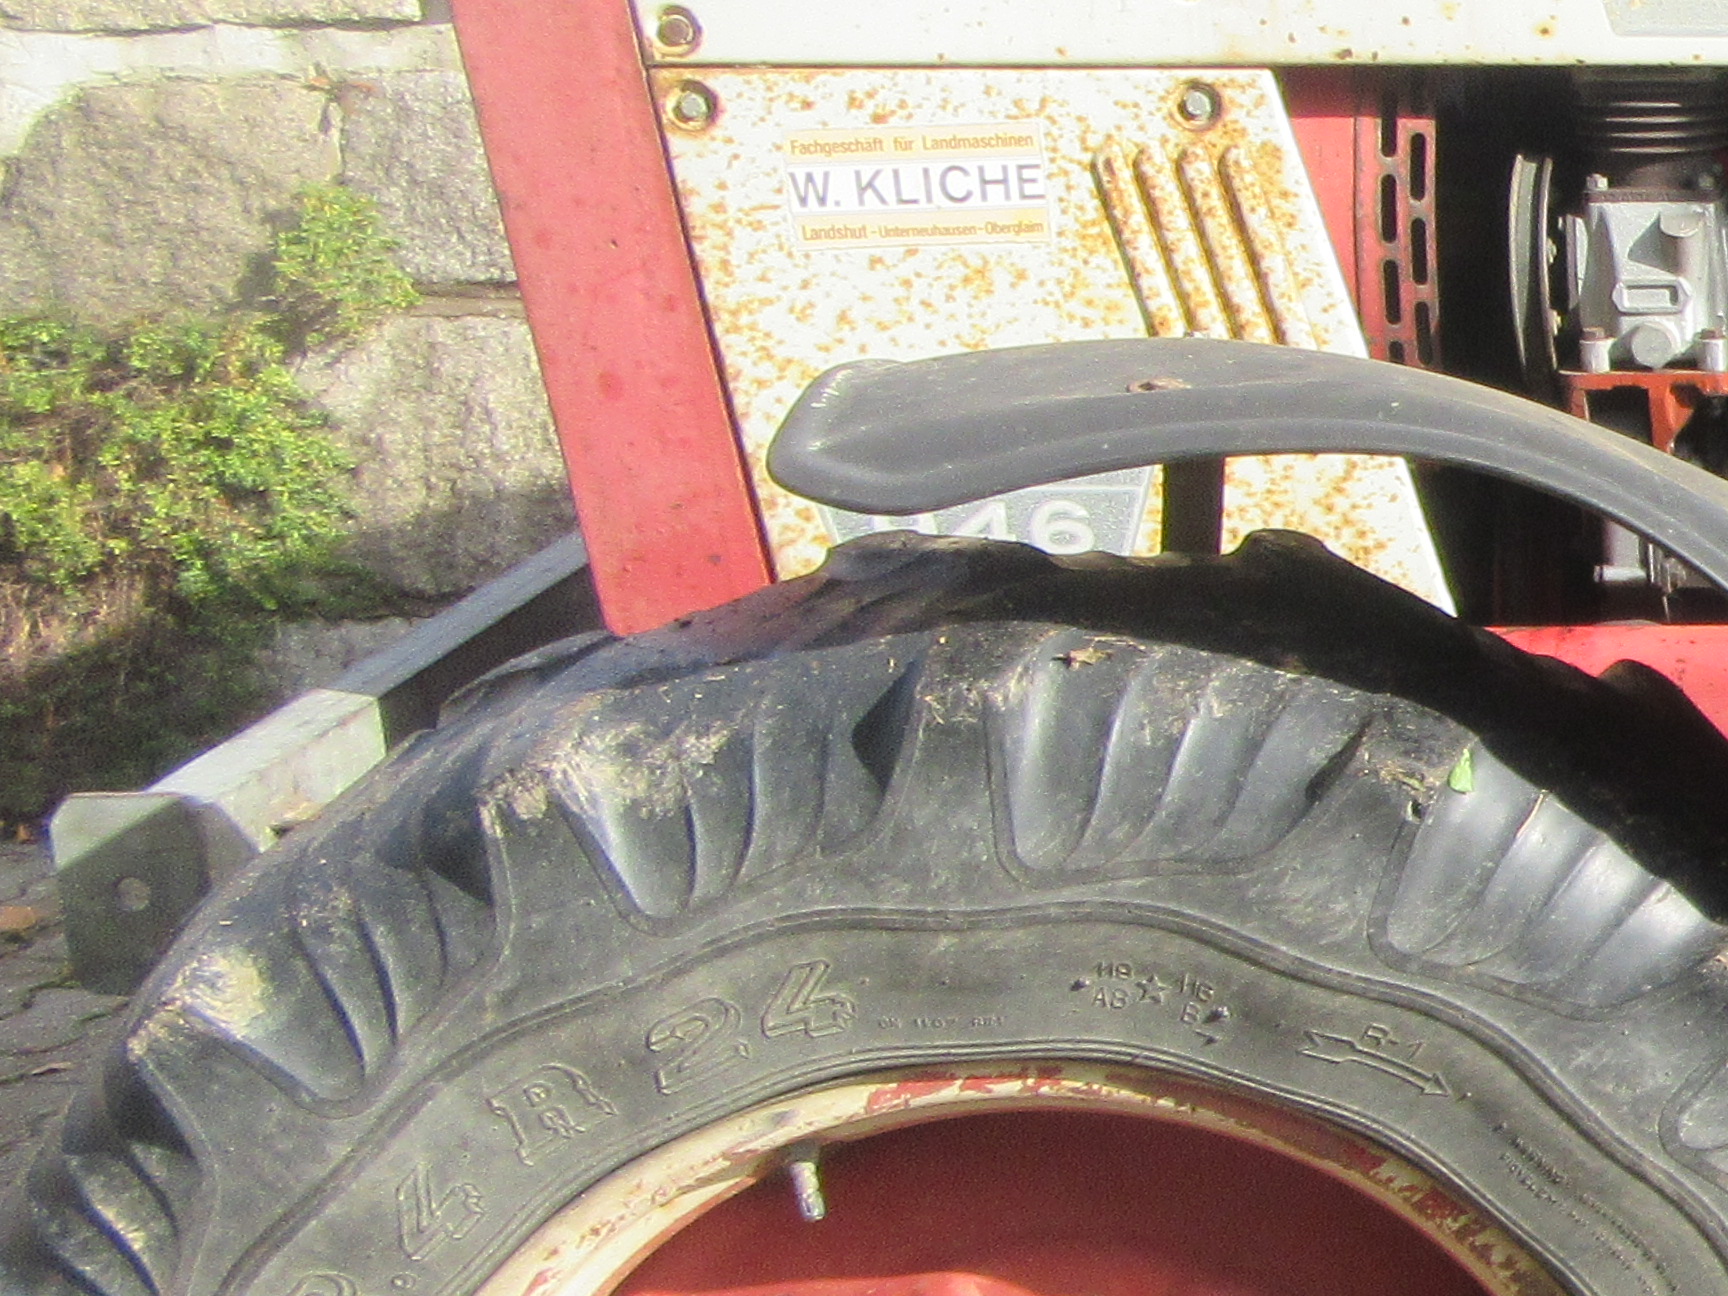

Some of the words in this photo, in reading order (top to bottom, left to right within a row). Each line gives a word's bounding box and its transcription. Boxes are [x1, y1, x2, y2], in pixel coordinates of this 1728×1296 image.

[789, 137, 884, 156] Fachgeschäft
[894, 135, 913, 152] für
[922, 133, 1034, 151] Landmaschinen
[788, 169, 841, 208] W.
[853, 162, 1047, 207] KLICHE
